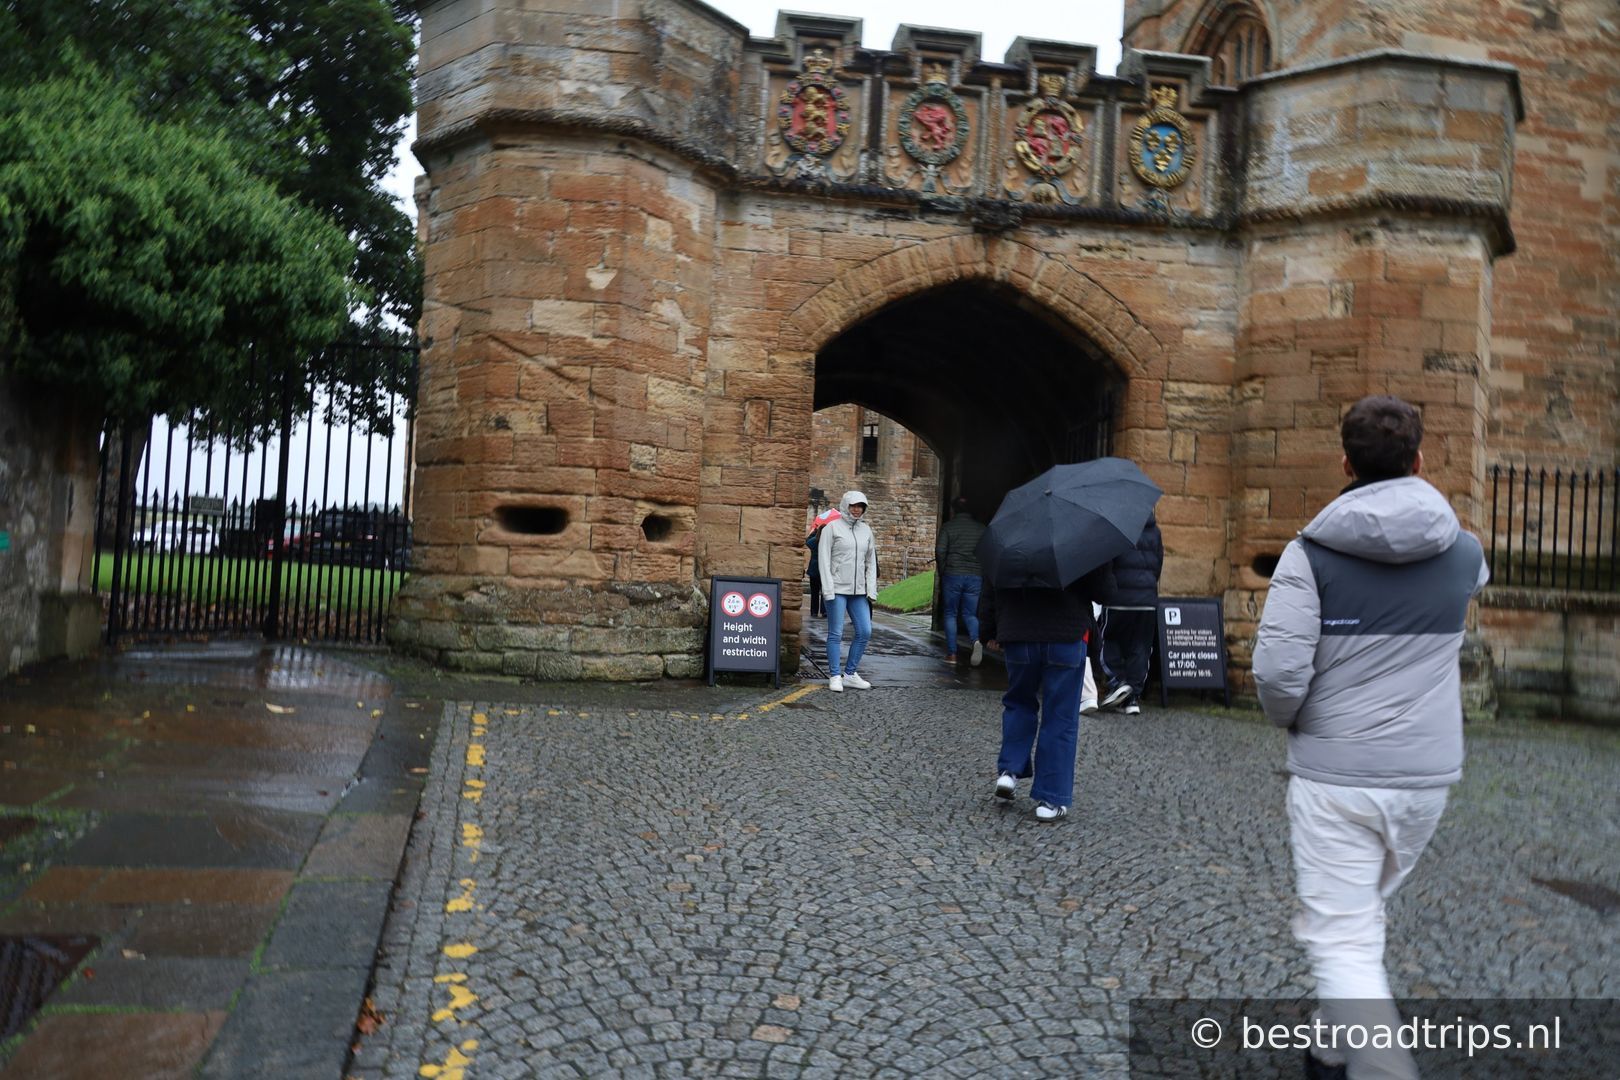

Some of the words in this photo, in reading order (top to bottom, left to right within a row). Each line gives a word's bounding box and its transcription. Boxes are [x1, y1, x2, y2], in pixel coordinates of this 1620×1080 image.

[1169, 611, 1177, 622] P
[723, 622, 753, 633] Height
[722, 635, 740, 644] and
[742, 636, 767, 645] width
[722, 648, 768, 658] restriction
[1168, 651, 1180, 660] Car
[1181, 651, 1197, 660] park
[1197, 651, 1218, 660] closes
[1168, 661, 1176, 669] at
[1182, 670, 1198, 678] entry
